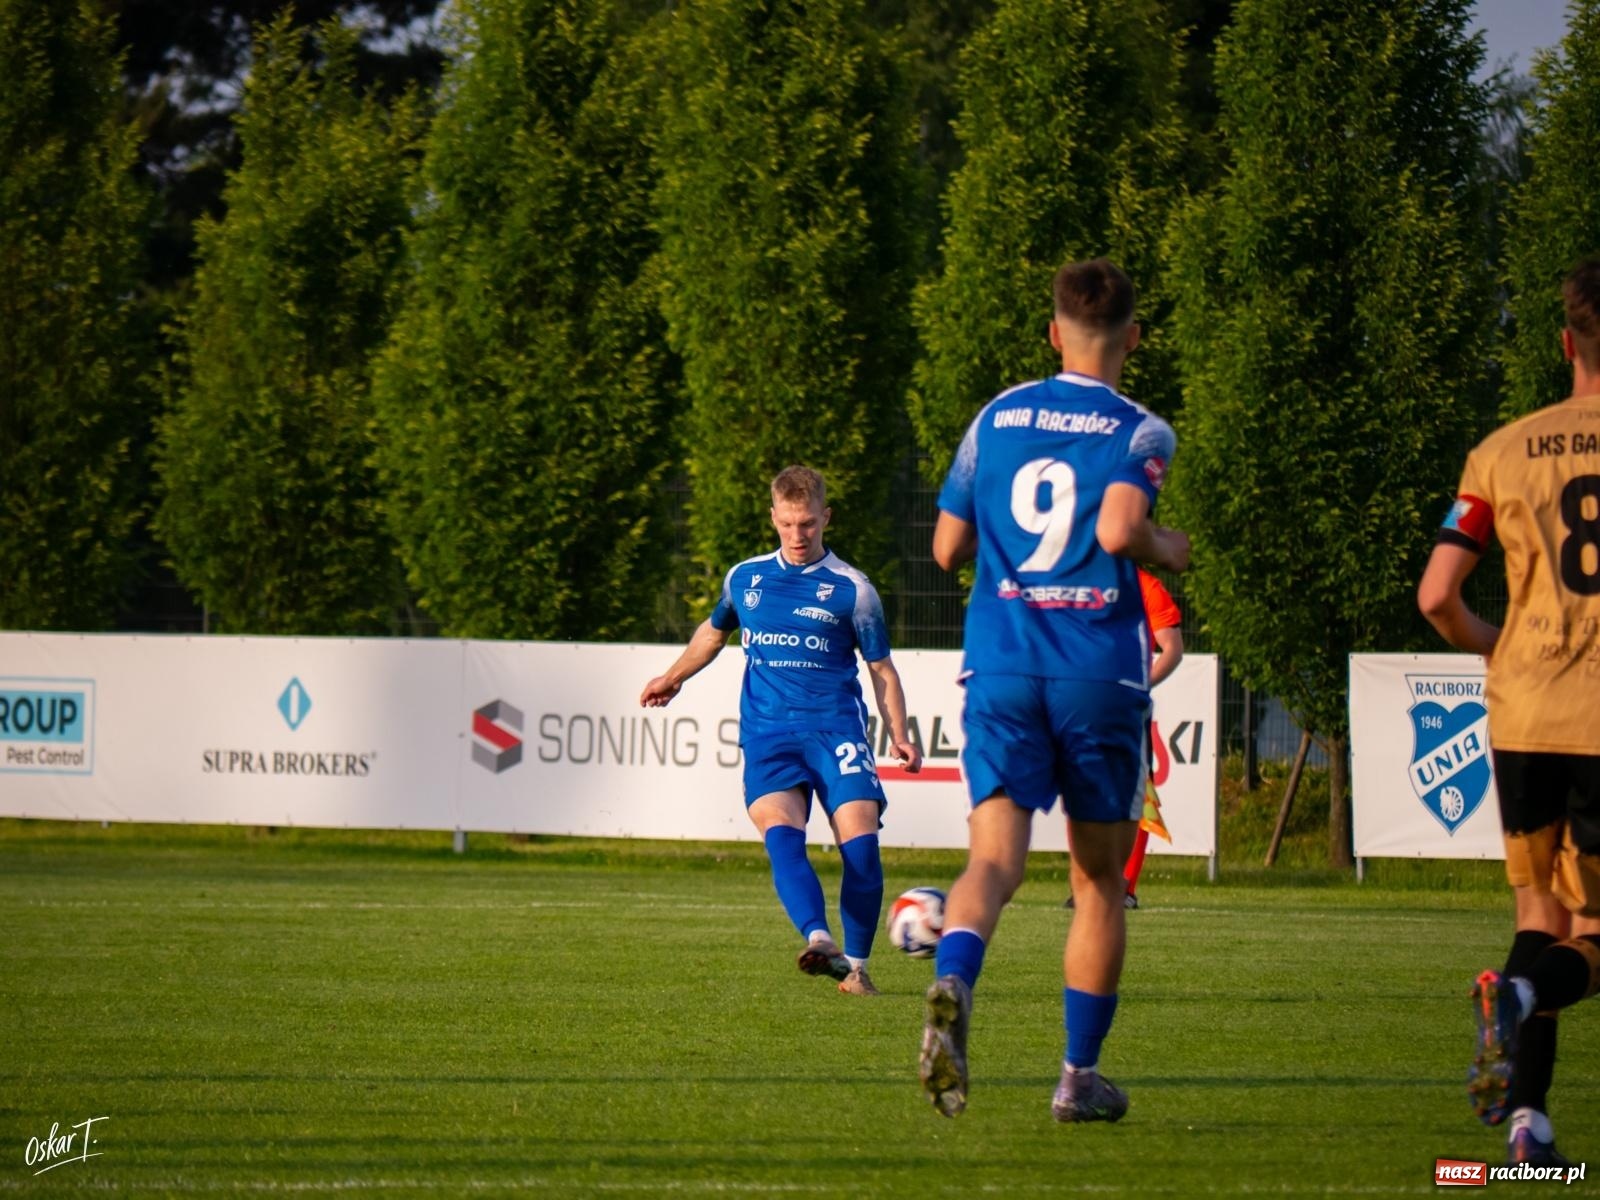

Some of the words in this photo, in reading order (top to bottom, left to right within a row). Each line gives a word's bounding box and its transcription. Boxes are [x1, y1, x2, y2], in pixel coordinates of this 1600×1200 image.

[993, 408, 1033, 428] UNIA
[1036, 410, 1121, 435] RACIBÓRZ
[1527, 433, 1566, 459] LKS
[1572, 432, 1600, 455] GA
[1010, 457, 1076, 572] 9
[1561, 474, 1600, 597] 8
[751, 631, 801, 647] Marco
[805, 635, 830, 652] Oil
[1416, 682, 1482, 697] RACIBORZ
[1420, 715, 1443, 730] 1946
[538, 713, 699, 768] SONING
[716, 718, 742, 768] S
[6, 747, 35, 765] Pest
[38, 747, 85, 767] Control
[202, 750, 267, 775] SUPRA
[835, 741, 877, 775] 23
[1416, 731, 1481, 786] UNIA
